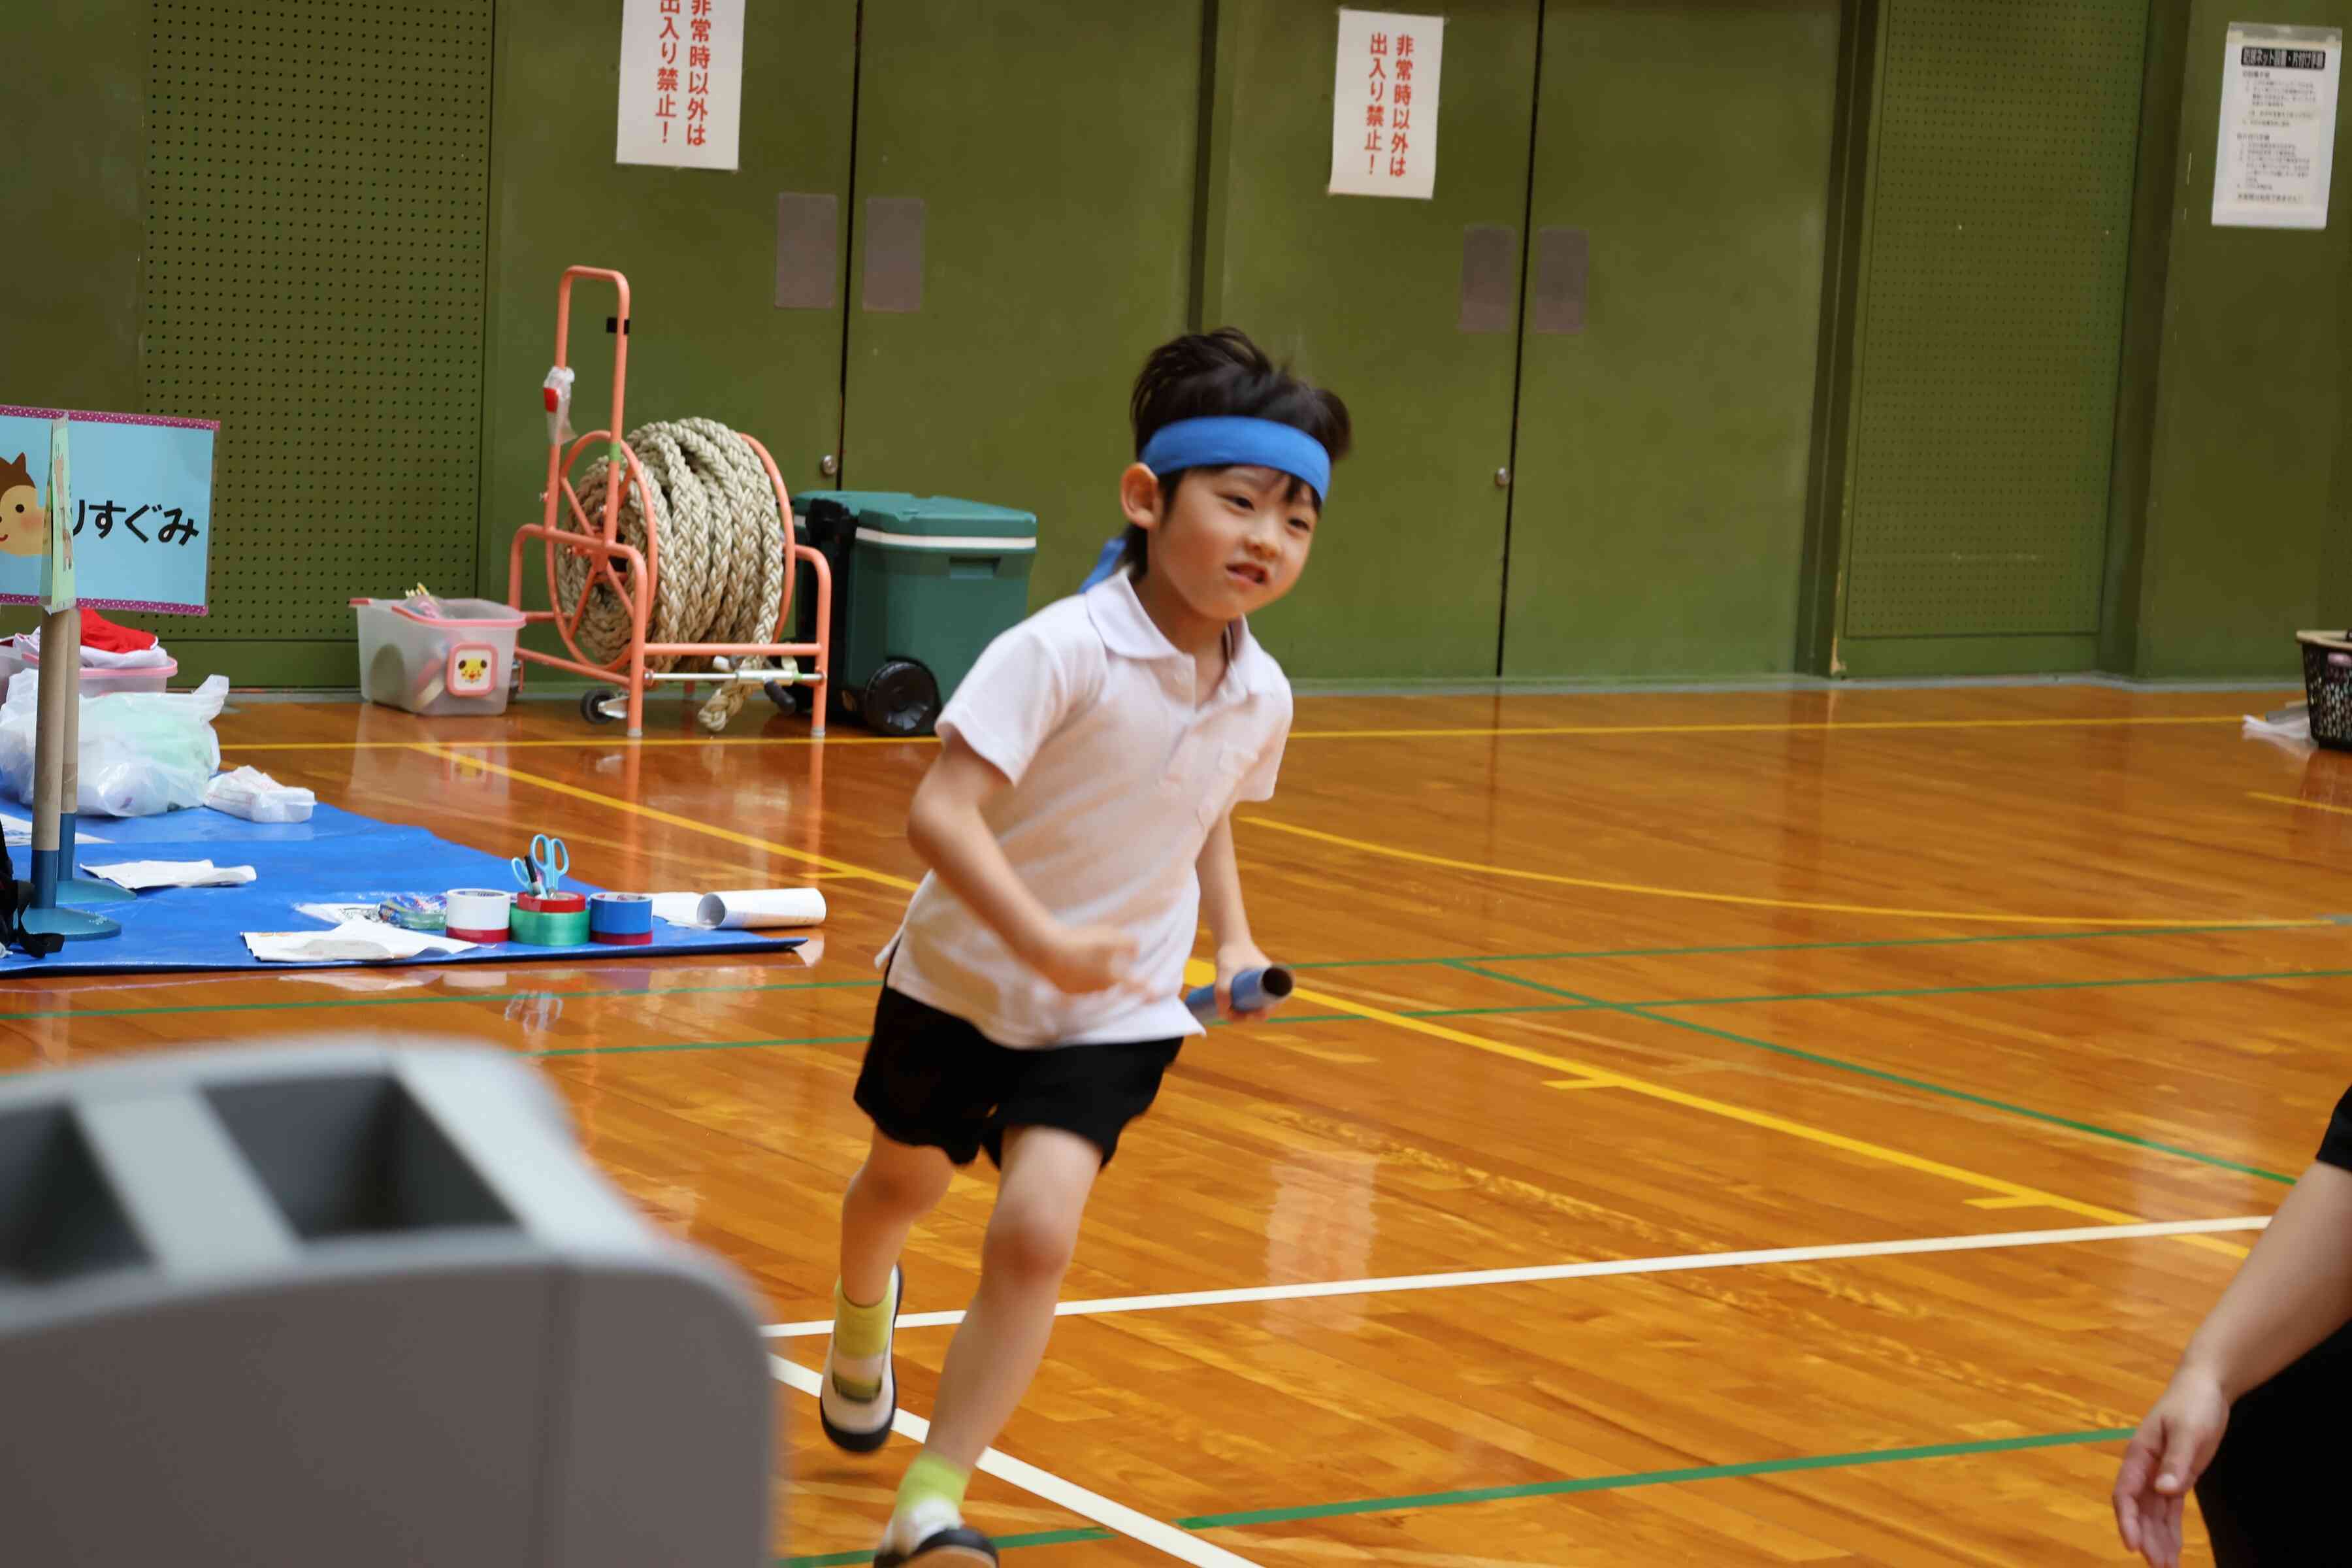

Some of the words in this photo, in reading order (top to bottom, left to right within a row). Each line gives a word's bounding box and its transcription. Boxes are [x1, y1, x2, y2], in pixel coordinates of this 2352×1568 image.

[687, 0, 712, 146] 非常時以外は
[1365, 32, 1388, 175] 出入り禁止！
[1390, 34, 1415, 177] 非常時以外は
